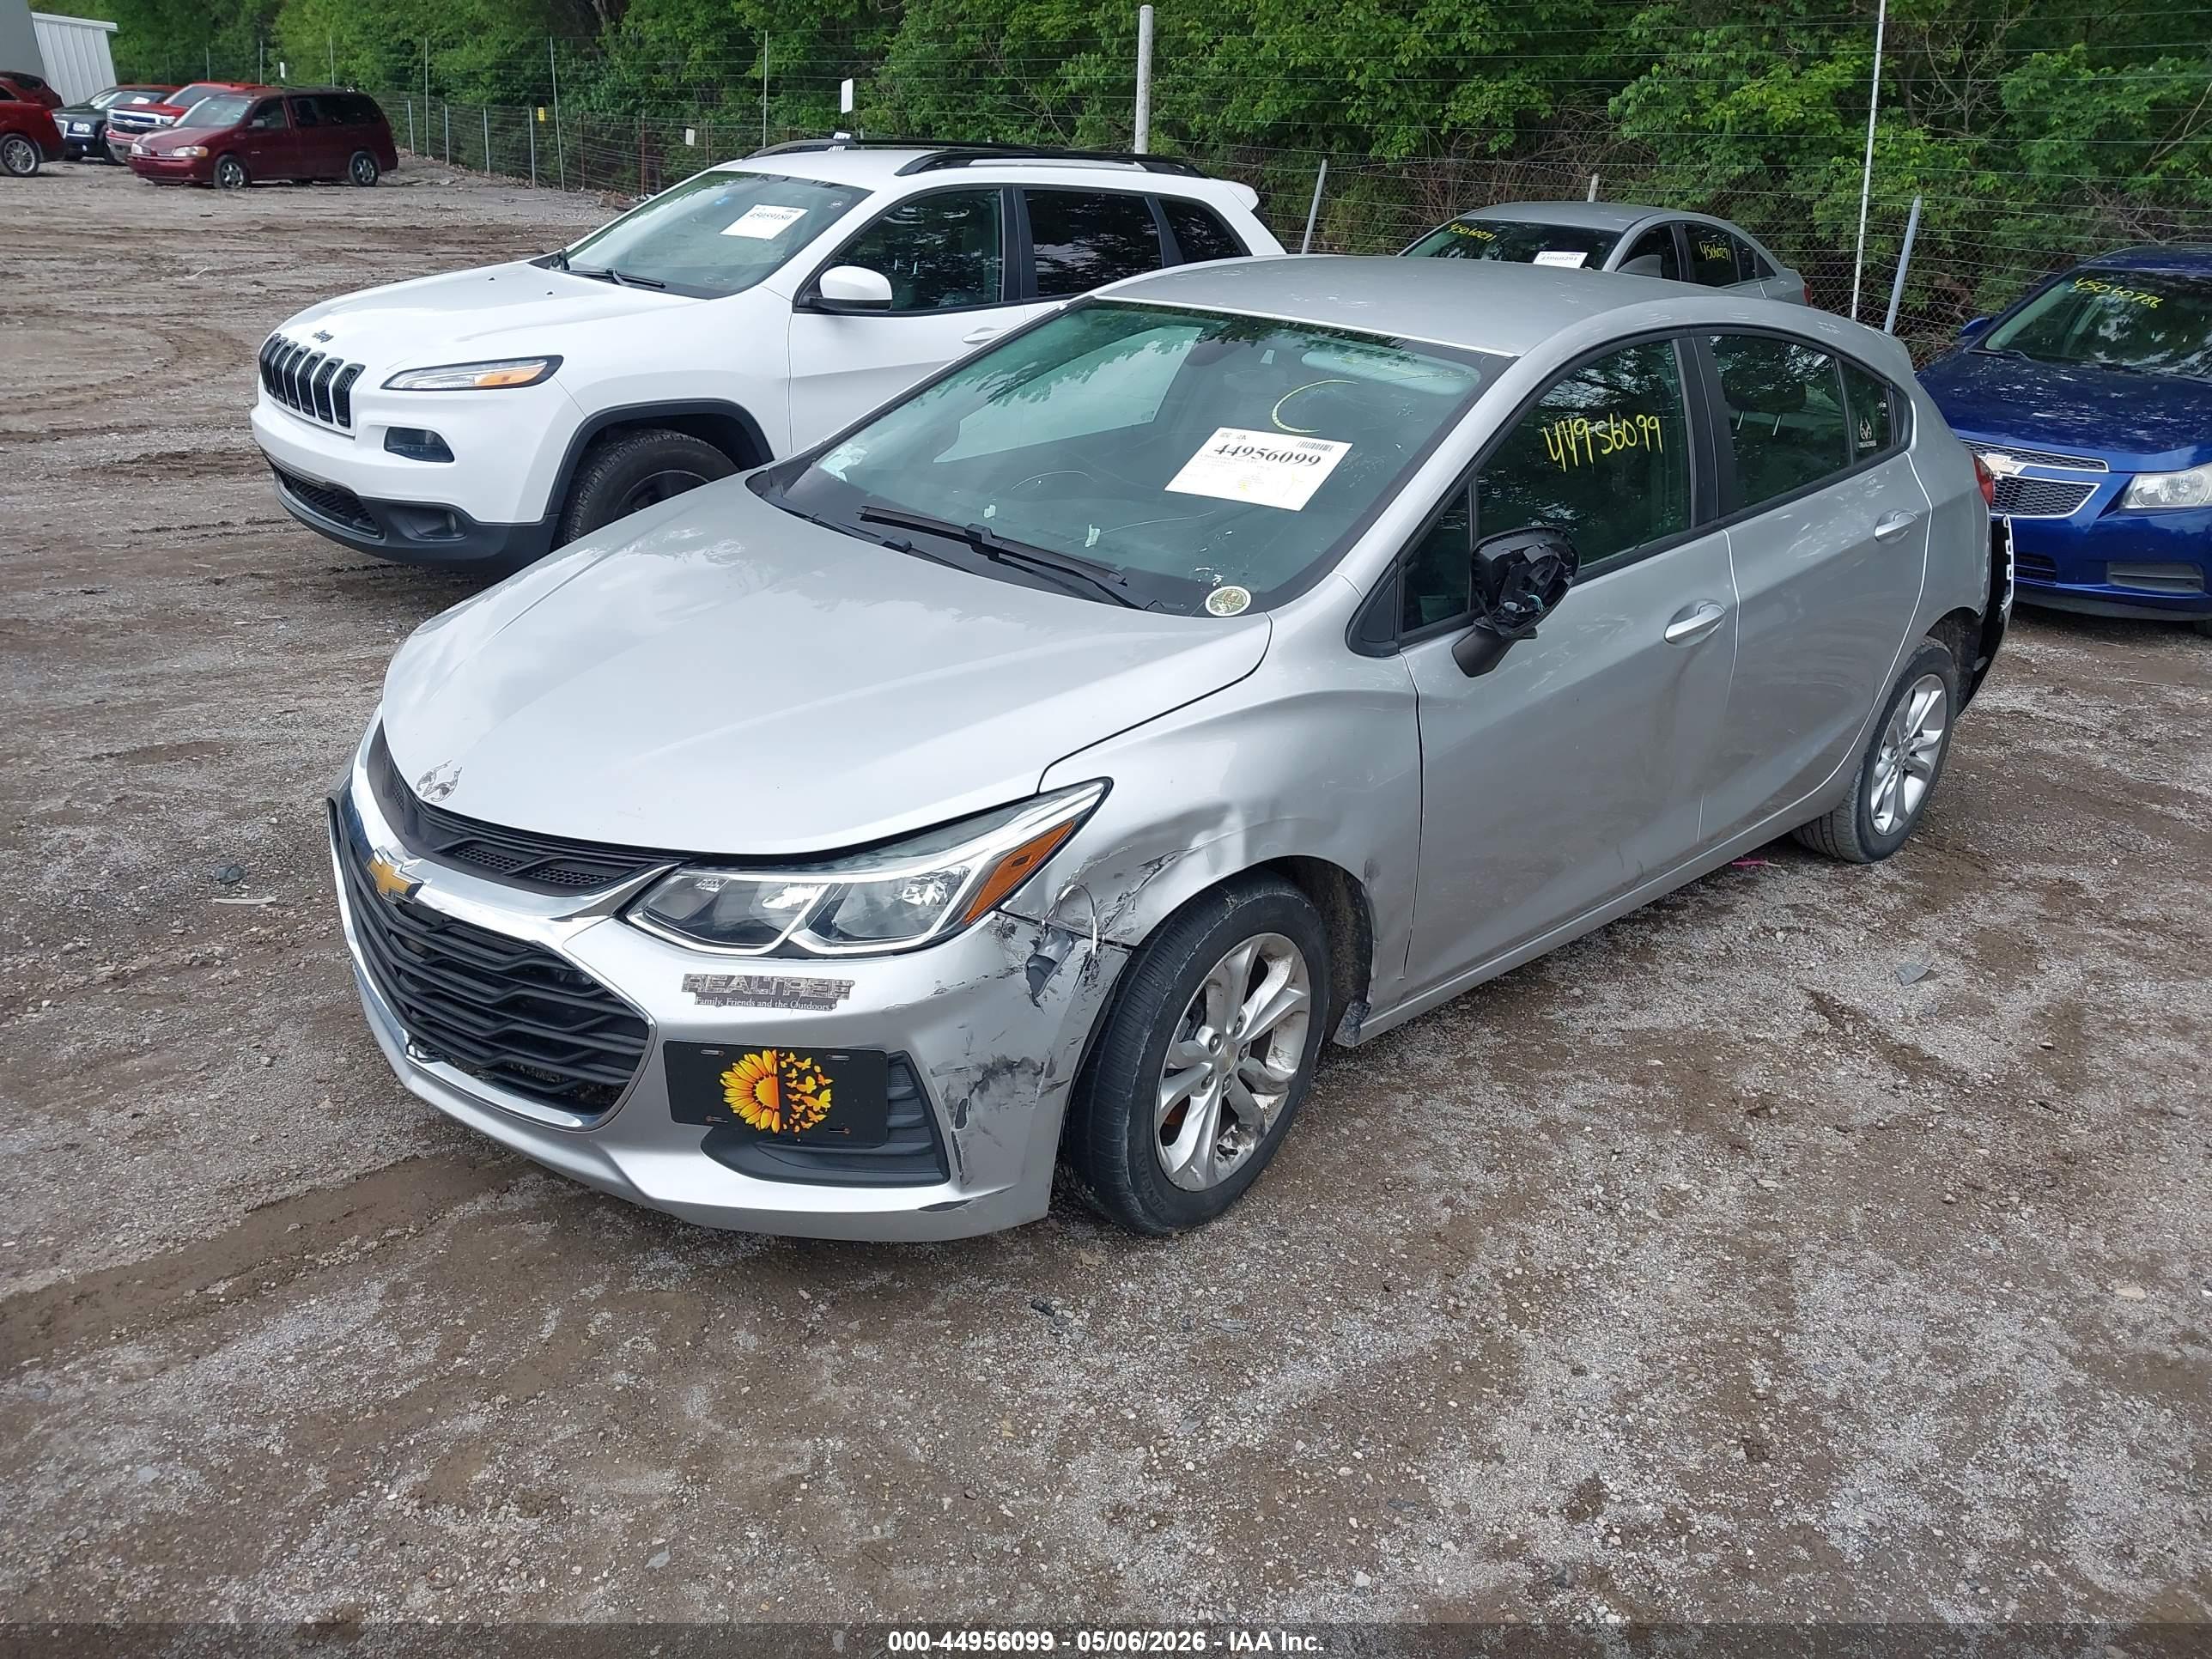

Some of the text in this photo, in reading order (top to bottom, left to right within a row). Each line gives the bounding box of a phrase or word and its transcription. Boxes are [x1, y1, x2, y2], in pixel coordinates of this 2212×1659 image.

[1447, 222, 1498, 242] 45060291
[2072, 276, 2164, 308] 45060786
[1213, 442, 1322, 467] 44956099
[1543, 412, 1663, 472] 44956099
[682, 974, 851, 1000] REALTREE
[726, 997, 757, 1007] Friends
[757, 999, 773, 1008] and
[775, 999, 789, 1009] the
